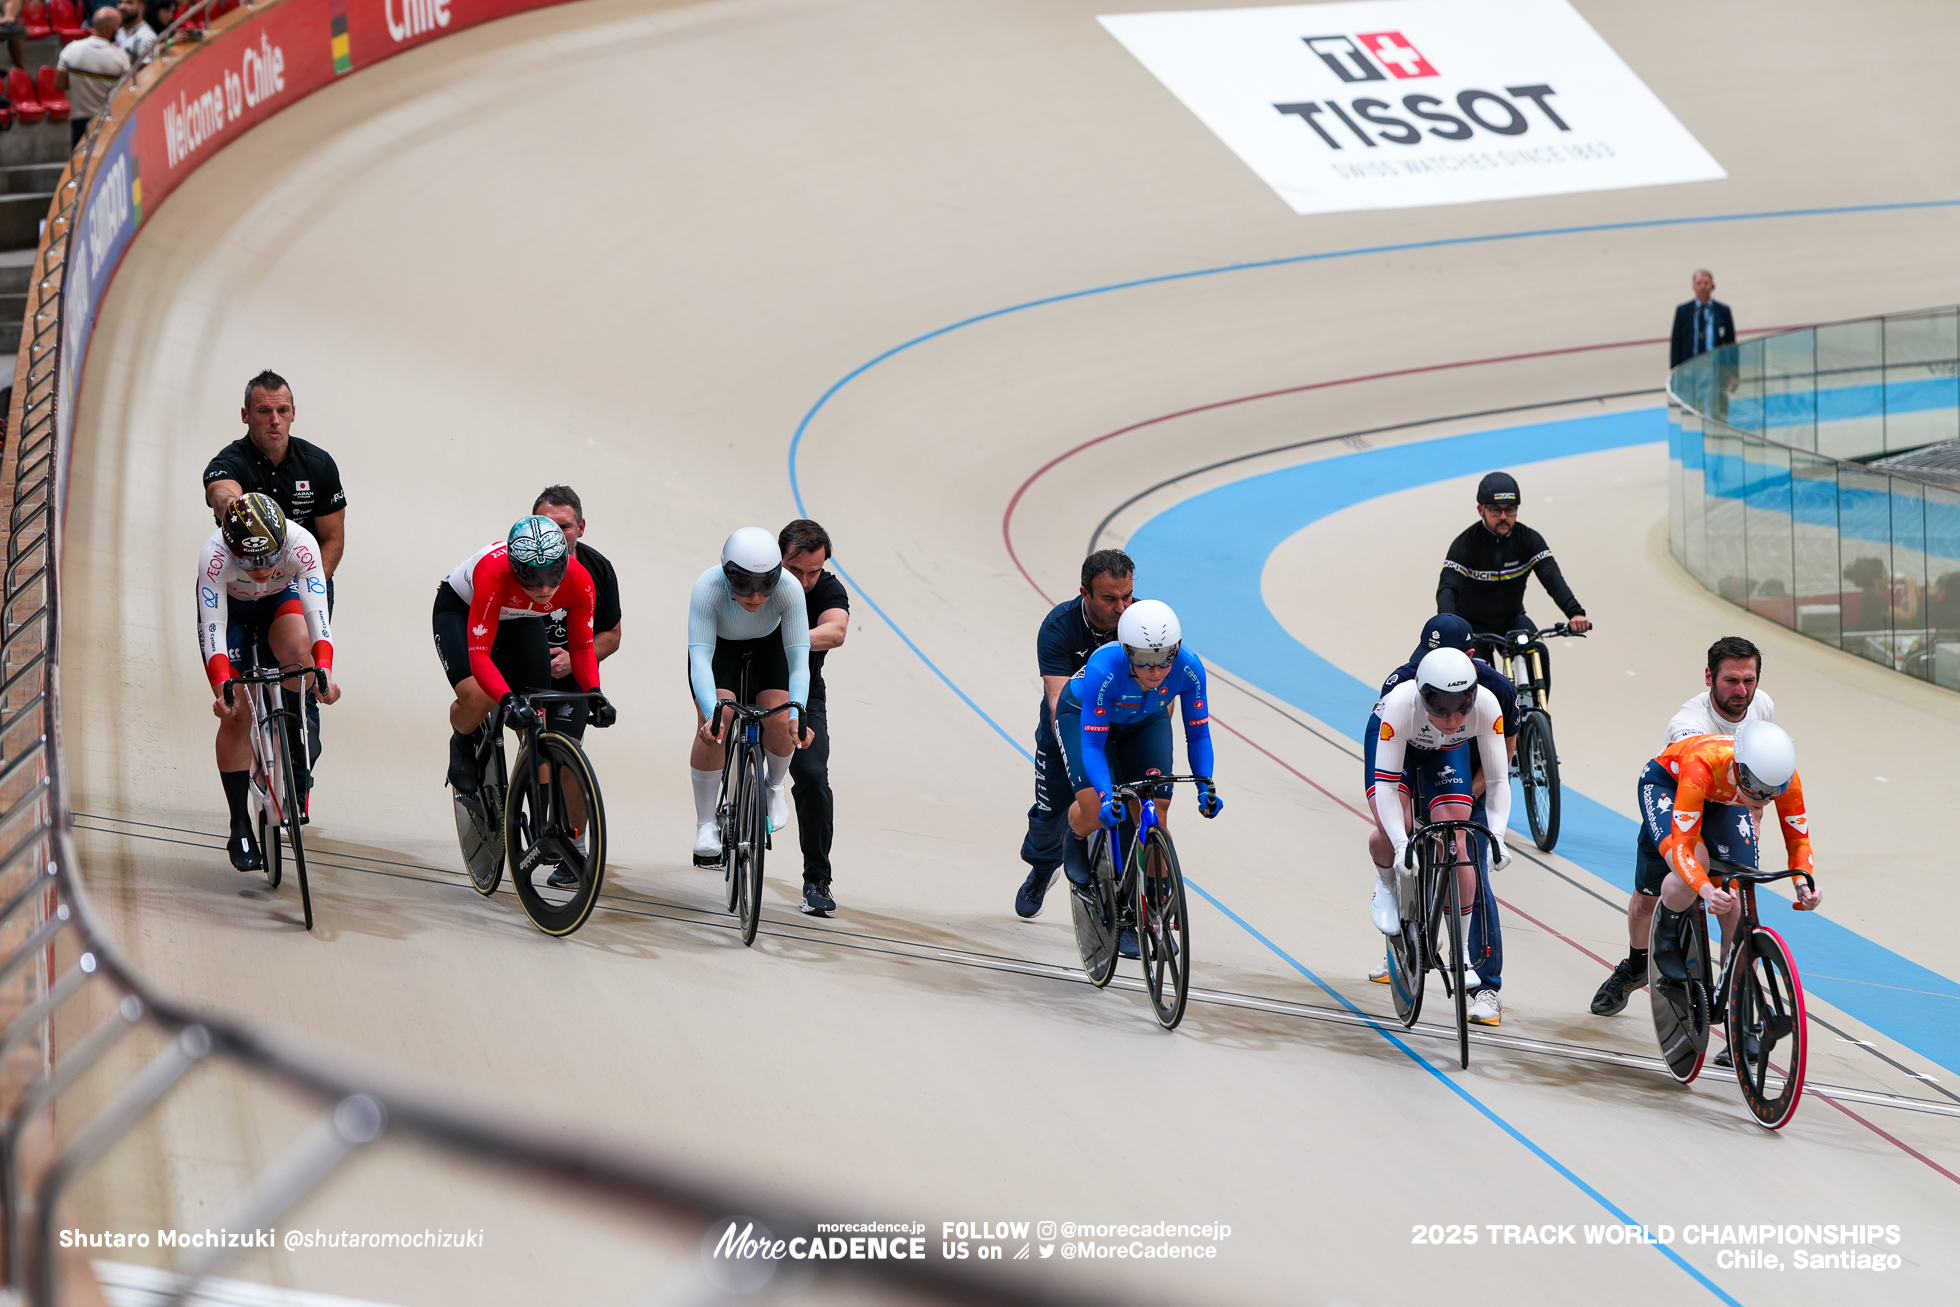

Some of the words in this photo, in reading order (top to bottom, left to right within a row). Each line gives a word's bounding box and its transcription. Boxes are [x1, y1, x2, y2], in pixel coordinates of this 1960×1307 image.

[163, 84, 224, 169] Welcome
[225, 69, 242, 122] to
[243, 29, 285, 108] Chile
[1272, 84, 1573, 150] TISSOT
[1331, 161, 1400, 179] SWISS
[1400, 152, 1500, 176] WATCHES
[1498, 146, 1567, 167] SINCE
[1473, 571, 1490, 580] UCI
[1447, 680, 1468, 688] LAZER
[1035, 749, 1052, 812] ITALIA
[1434, 777, 1464, 787] LLOYDS
[1643, 784, 1664, 842] Staatsloterij
[1676, 844, 1696, 884] Staatsloterij
